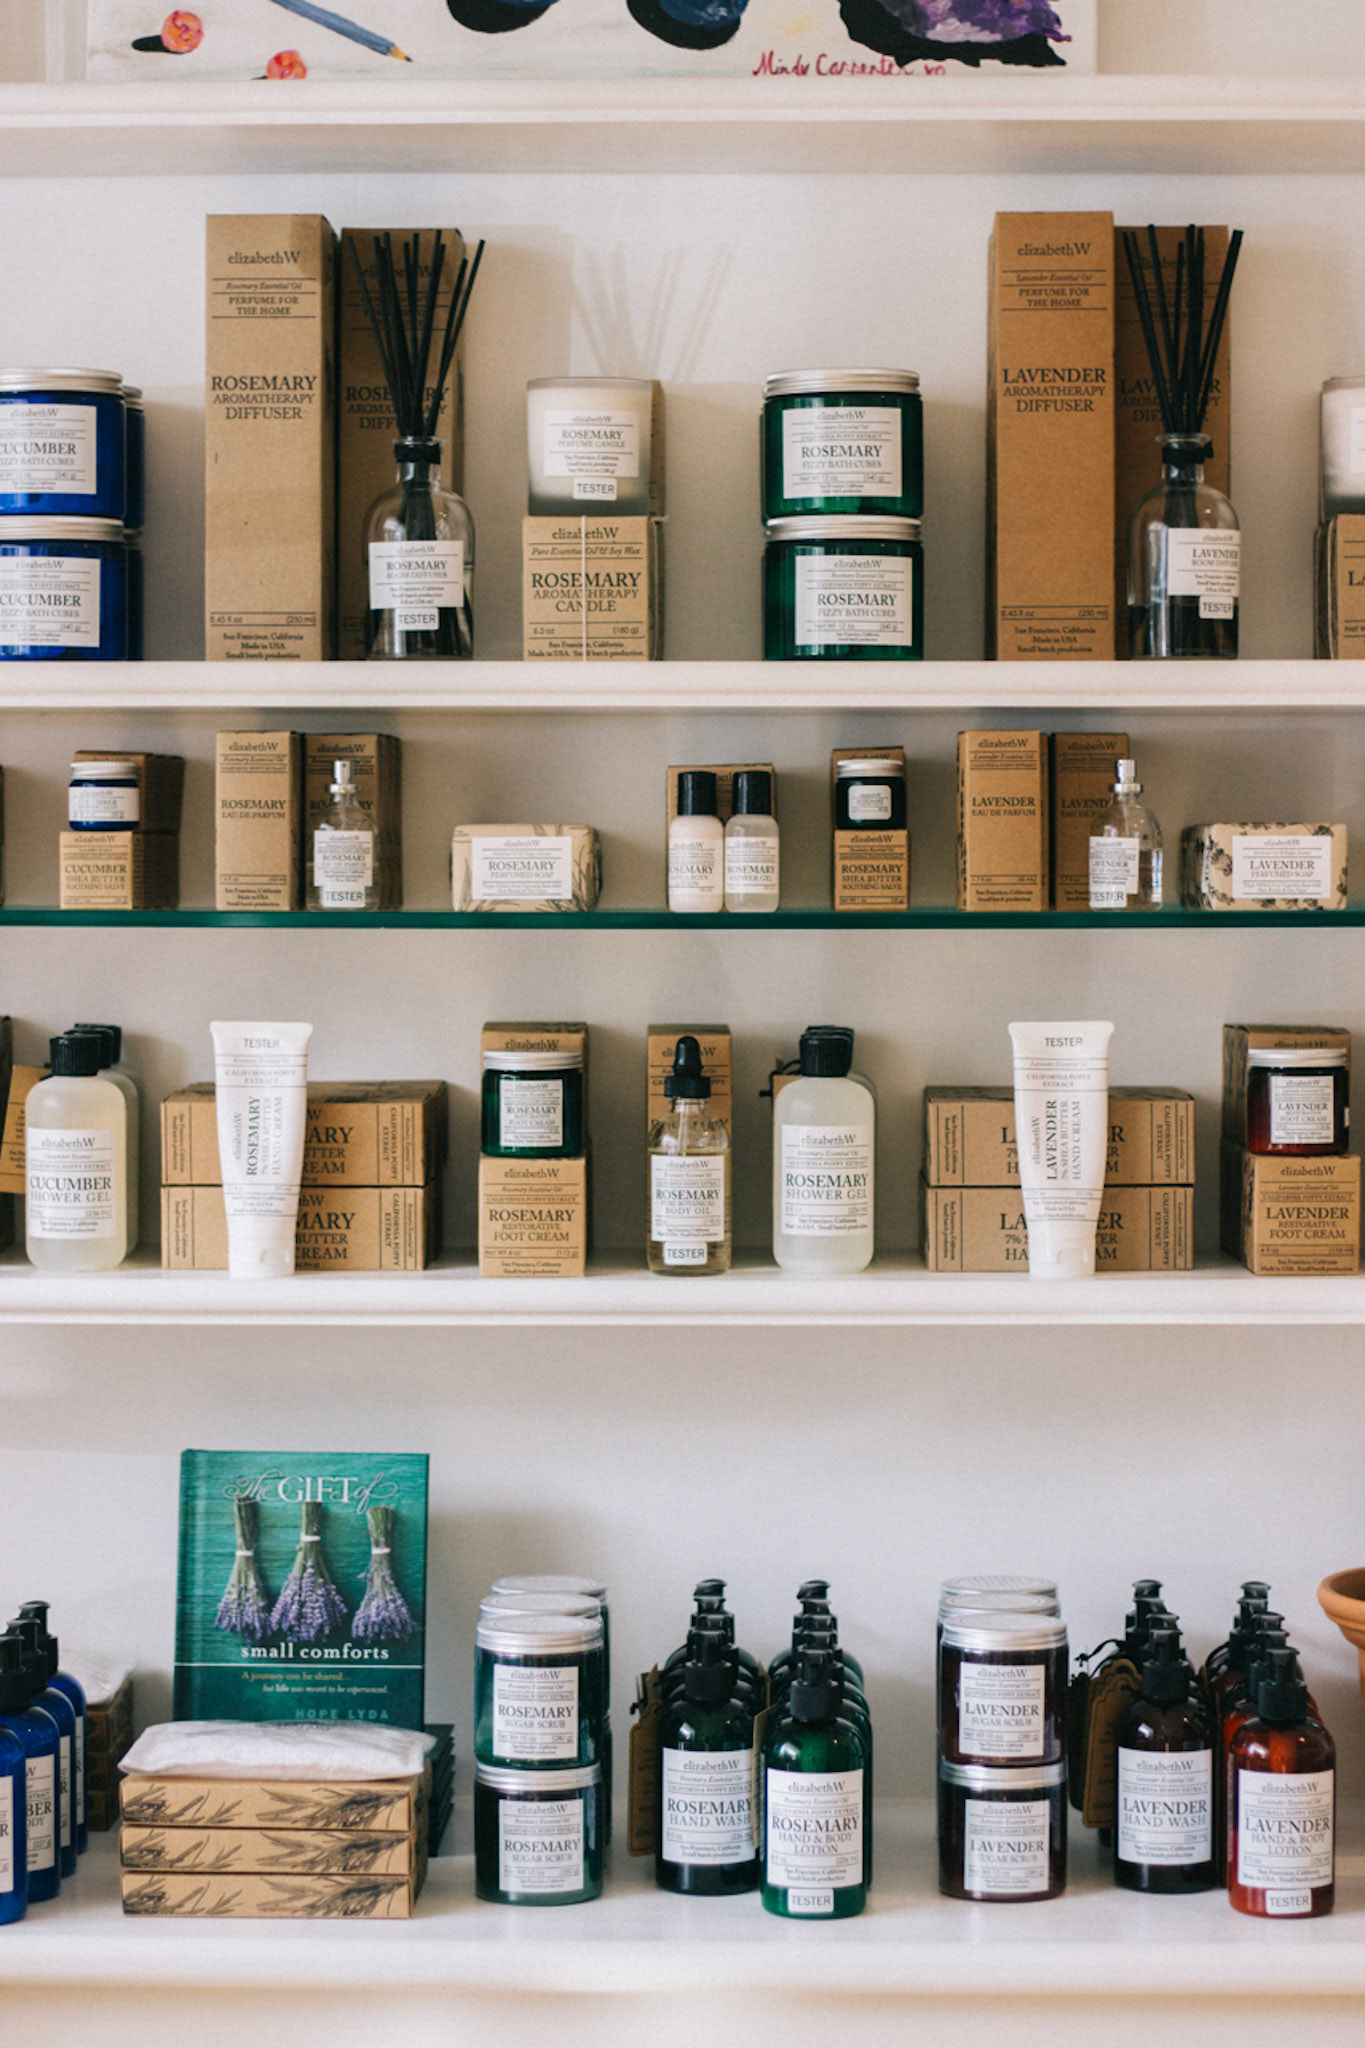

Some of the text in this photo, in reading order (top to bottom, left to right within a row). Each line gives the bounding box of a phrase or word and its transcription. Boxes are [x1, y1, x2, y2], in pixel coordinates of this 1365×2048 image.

[1017, 242, 1091, 256] elizabethW
[228, 251, 301, 264] elizabethW
[1018, 288, 1090, 296] PERFUME FOR
[228, 296, 299, 305] PERFUME FOR
[1026, 299, 1082, 307] THE HOME
[236, 307, 291, 315] THE HOME
[1002, 368, 1106, 383] LAVENDER
[211, 376, 318, 390] ROSEMARY
[1003, 386, 1106, 397] AROMATHERAPY
[213, 393, 315, 404] AROMATHERAPY
[1016, 399, 1095, 412] DIFFUSER
[226, 407, 302, 419] DIFFUSER
[561, 430, 624, 440] ROSEMARY
[801, 445, 883, 458] ROSEMARY
[802, 460, 882, 470] FIZZY BATH CUBES
[577, 483, 615, 494] TESTER
[386, 560, 448, 571] ROSEMARY
[531, 572, 641, 588] ROSEMARY
[0, 594, 82, 606] CUCUMBER
[817, 593, 897, 606] ROSEMARY
[817, 609, 896, 617] FIZZY BATH CUBES
[1203, 603, 1232, 613] TESTER
[398, 614, 437, 624] TESTER
[228, 742, 279, 752] elizabethW
[978, 738, 1029, 748] elizabethW
[221, 799, 287, 810] ROSEMARY
[972, 797, 1036, 807] LAVENDER
[971, 809, 987, 817] EAU
[1003, 809, 1036, 817] PARFUM
[65, 864, 127, 874] CUCUMBER
[488, 861, 557, 871] ROSEMARY
[841, 864, 903, 874] ROSEMARY
[1249, 860, 1315, 870] LAVENDER
[325, 891, 363, 901] TESTER
[244, 1038, 280, 1048] TESTER
[1044, 1036, 1083, 1047] TESTER
[507, 1106, 558, 1115] ROSEMARY
[1278, 1102, 1329, 1111] LAVENDER
[246, 1096, 261, 1176] ROSEMARY
[801, 1135, 856, 1145] elizabethW
[1046, 1099, 1058, 1181] LAVENDER
[1072, 1101, 1082, 1181] HAND CREAM
[504, 1167, 560, 1178] elizabethW
[1280, 1165, 1337, 1176] elizabethW
[30, 1176, 111, 1190] CUCUMBER
[786, 1173, 868, 1187] ROSEMARY
[30, 1191, 111, 1203] SHOWER GEL
[655, 1189, 720, 1201] ROSEMARY
[785, 1188, 868, 1200] SHOWER GEL
[488, 1209, 575, 1222] ROSEMARY
[1266, 1207, 1349, 1220] LAVENDER
[502, 1223, 560, 1231] RESTORATIVE
[1278, 1220, 1337, 1229] RESTORATIVE
[494, 1231, 570, 1242] FOOT CREAM
[1270, 1229, 1346, 1239] FOOT CREAM
[667, 1248, 705, 1258] TESTER
[223, 1468, 399, 1515] The GIFT of
[241, 1643, 389, 1660] small comforts
[241, 1671, 249, 1680] A
[250, 1671, 284, 1683] journey
[302, 1671, 312, 1681] be
[510, 1670, 561, 1680] elizabethW
[977, 1667, 1028, 1678] elizabethW
[275, 1683, 289, 1692] life
[296, 1708, 389, 1719] HOPE LYDA
[497, 1704, 575, 1719] ROSEMARY
[965, 1702, 1040, 1717] LAVENDER
[504, 1719, 566, 1729] SUGAR SCRUB
[971, 1717, 1032, 1727] SUGAR SCRUB
[683, 1760, 741, 1771] elizabethW
[1136, 1760, 1194, 1772] elizabethW
[788, 1781, 846, 1793] elizabethW
[1261, 1782, 1320, 1794] elizabethW
[517, 1804, 568, 1815] elizabethW
[667, 1797, 752, 1815] ROSEMARY
[1123, 1797, 1207, 1815] LAVENDER
[669, 1814, 710, 1828] HAND
[771, 1815, 861, 1834] ROSEMARY
[1123, 1813, 1207, 1827] HAND WASH
[1245, 1817, 1331, 1835] LAVENDER
[778, 1831, 854, 1844] HAND & BODY
[1251, 1832, 1326, 1844] HAND & BODY
[503, 1838, 581, 1853] ROSEMARY
[794, 1844, 840, 1855] LOTION
[970, 1839, 1045, 1853] LAVENDER
[1268, 1845, 1312, 1856] LOTION
[790, 1894, 831, 1906] TESTER
[1269, 1896, 1310, 1908] TESTER
